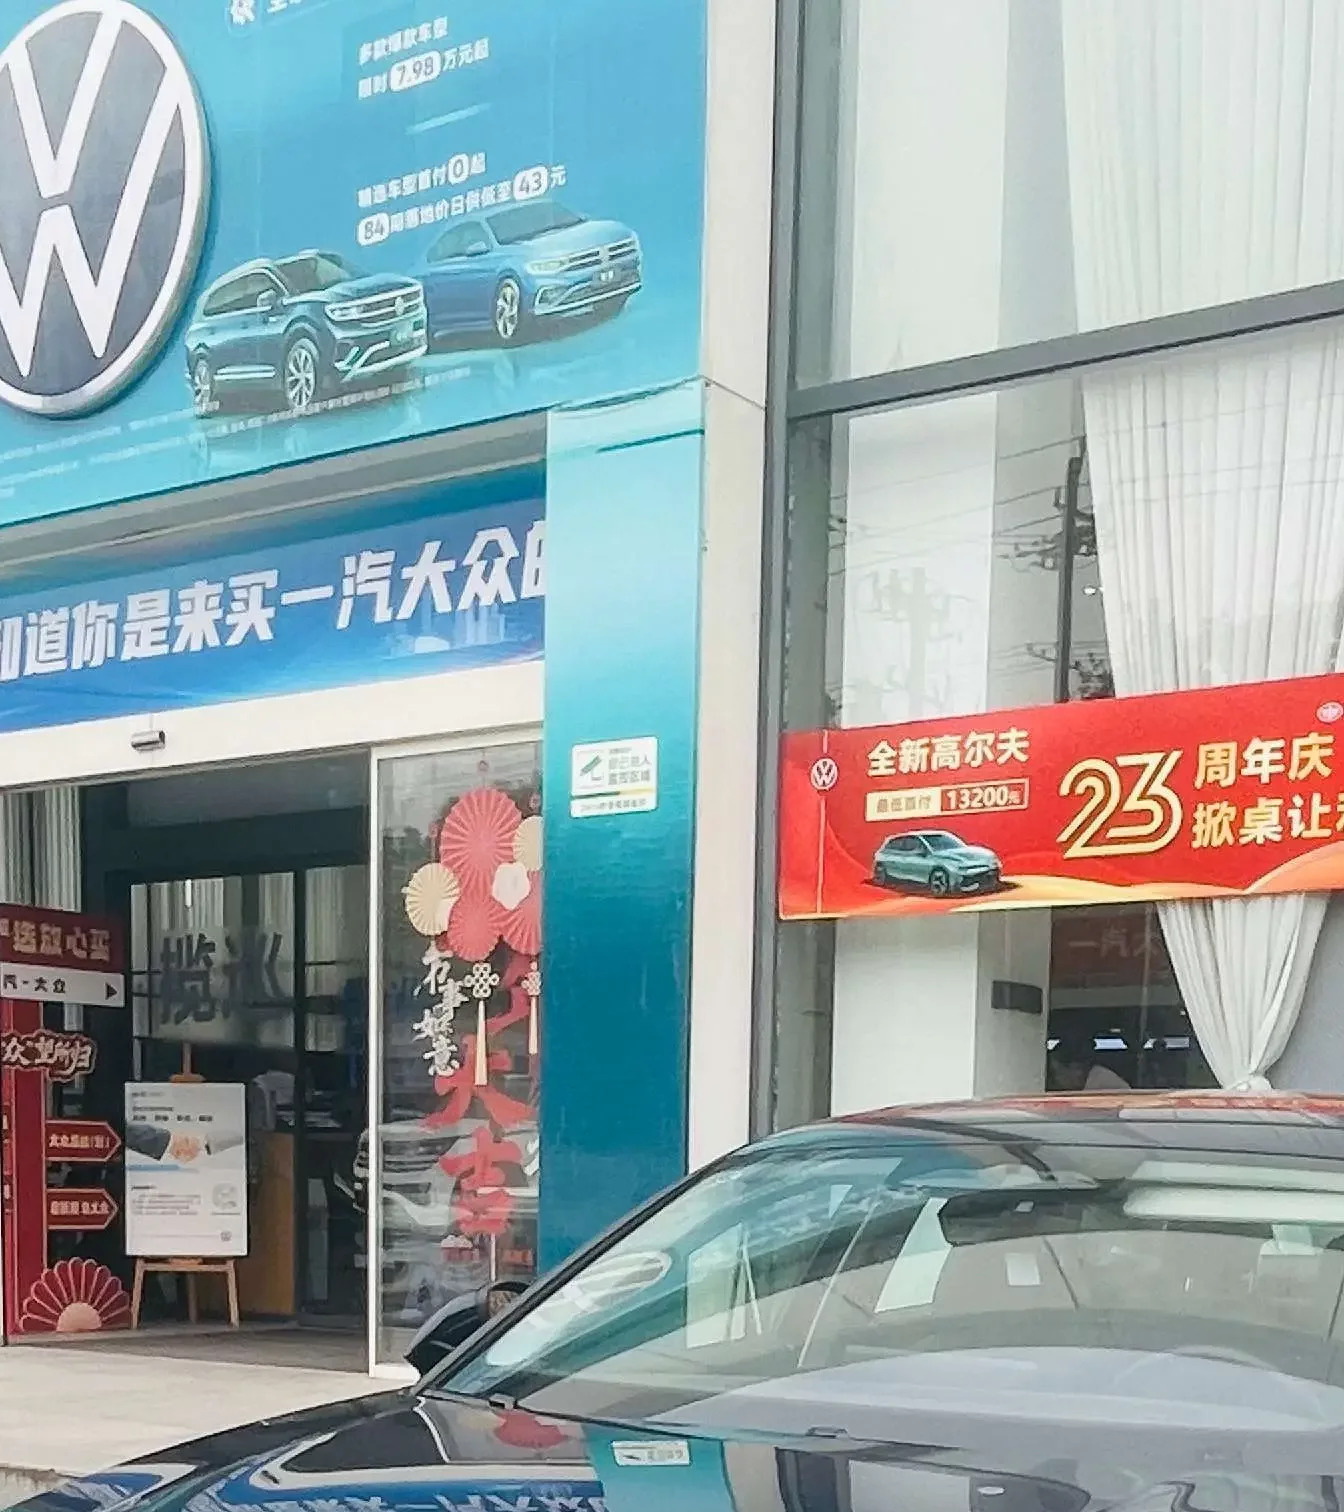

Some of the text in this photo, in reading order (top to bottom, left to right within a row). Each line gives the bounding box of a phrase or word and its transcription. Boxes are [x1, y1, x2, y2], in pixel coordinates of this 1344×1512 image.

[867, 726, 1029, 778] 全新高尔夫
[1195, 732, 1335, 789] 周年庆
[1057, 750, 1182, 860] 23
